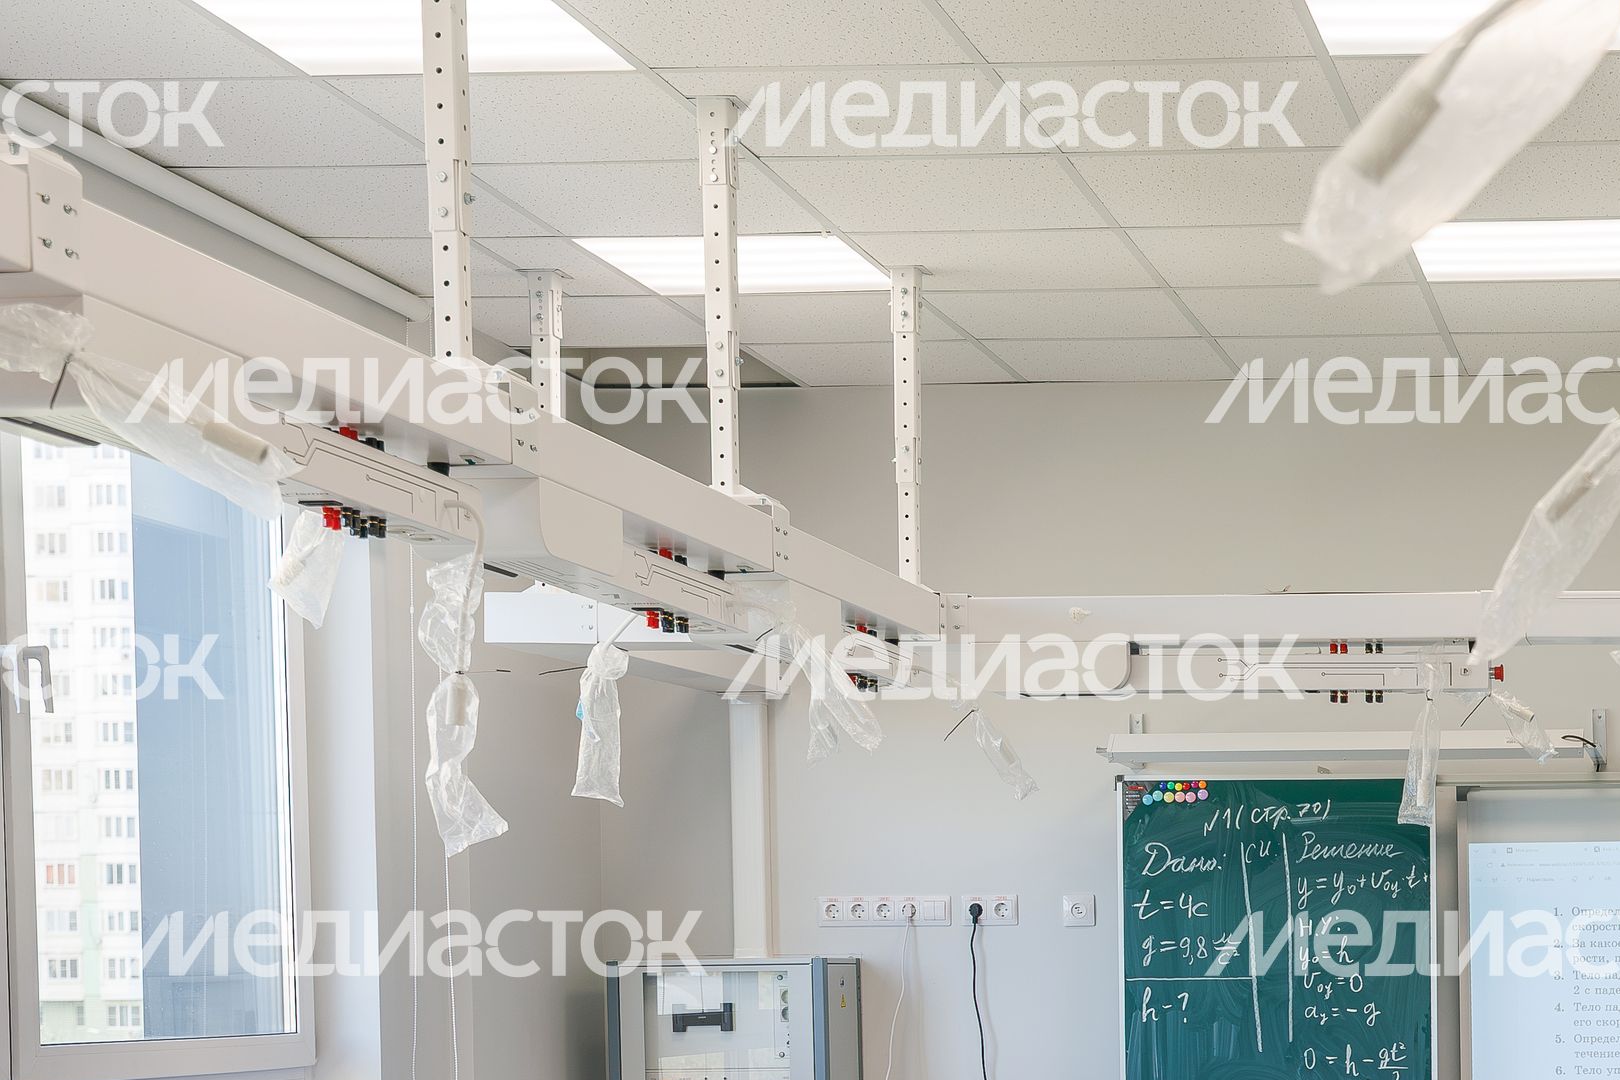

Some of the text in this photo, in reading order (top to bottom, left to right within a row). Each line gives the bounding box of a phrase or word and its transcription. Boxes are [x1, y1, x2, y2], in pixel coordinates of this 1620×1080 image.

[1296, 831, 1404, 864] Решение
[1572, 1001, 1602, 1013] Тело
[1572, 1018, 1593, 1028] его
[1573, 1050, 1620, 1060] течение
[1573, 1064, 1602, 1076] Тело
